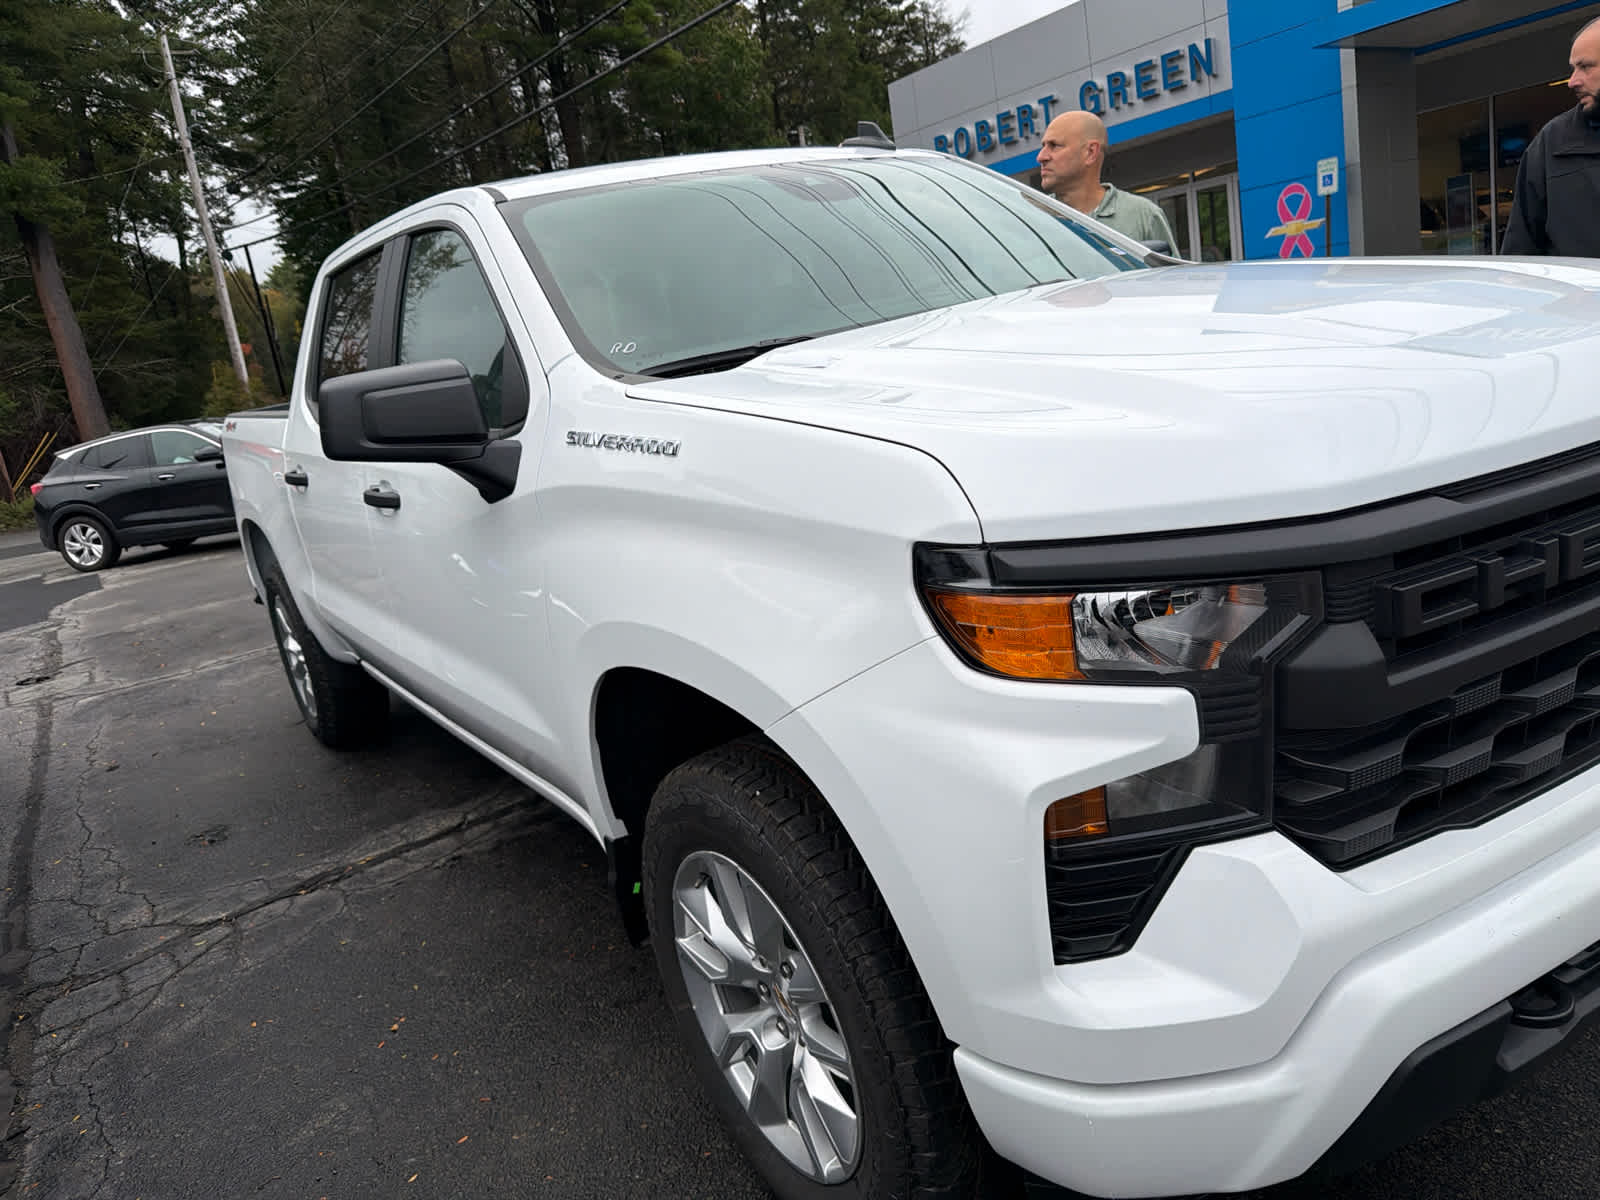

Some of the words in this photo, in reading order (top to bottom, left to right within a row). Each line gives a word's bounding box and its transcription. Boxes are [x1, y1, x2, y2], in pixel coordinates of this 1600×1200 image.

[933, 95, 1054, 158] ROBERT
[1079, 38, 1214, 114] GREEN
[566, 430, 681, 457] SILVERADO
